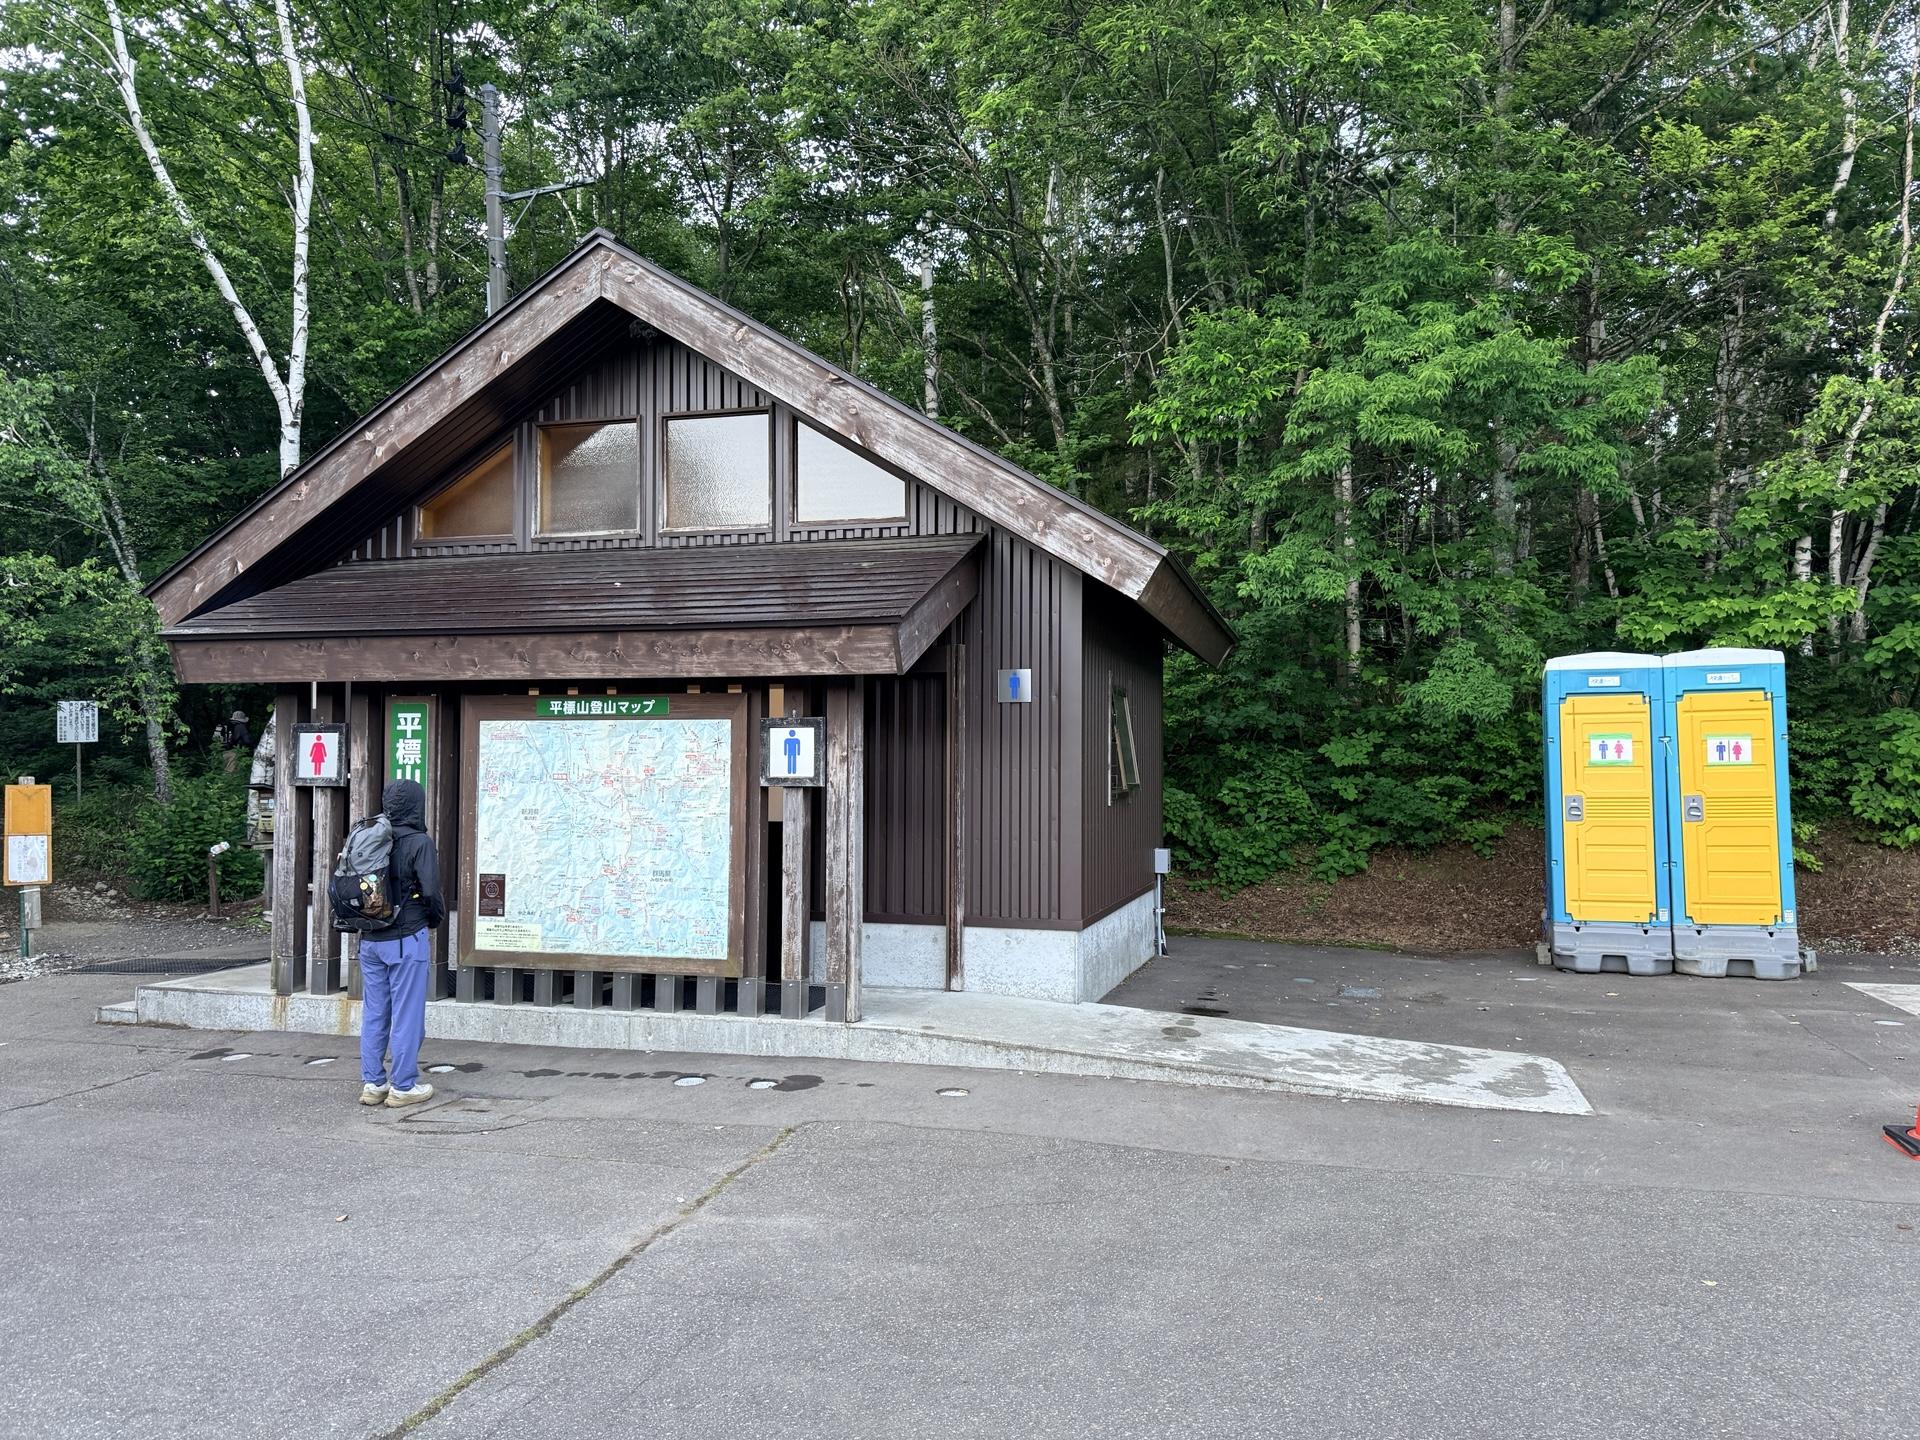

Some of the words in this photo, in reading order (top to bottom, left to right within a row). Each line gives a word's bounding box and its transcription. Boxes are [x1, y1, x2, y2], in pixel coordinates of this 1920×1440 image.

[550, 699, 656, 715] 平標山登山マップ
